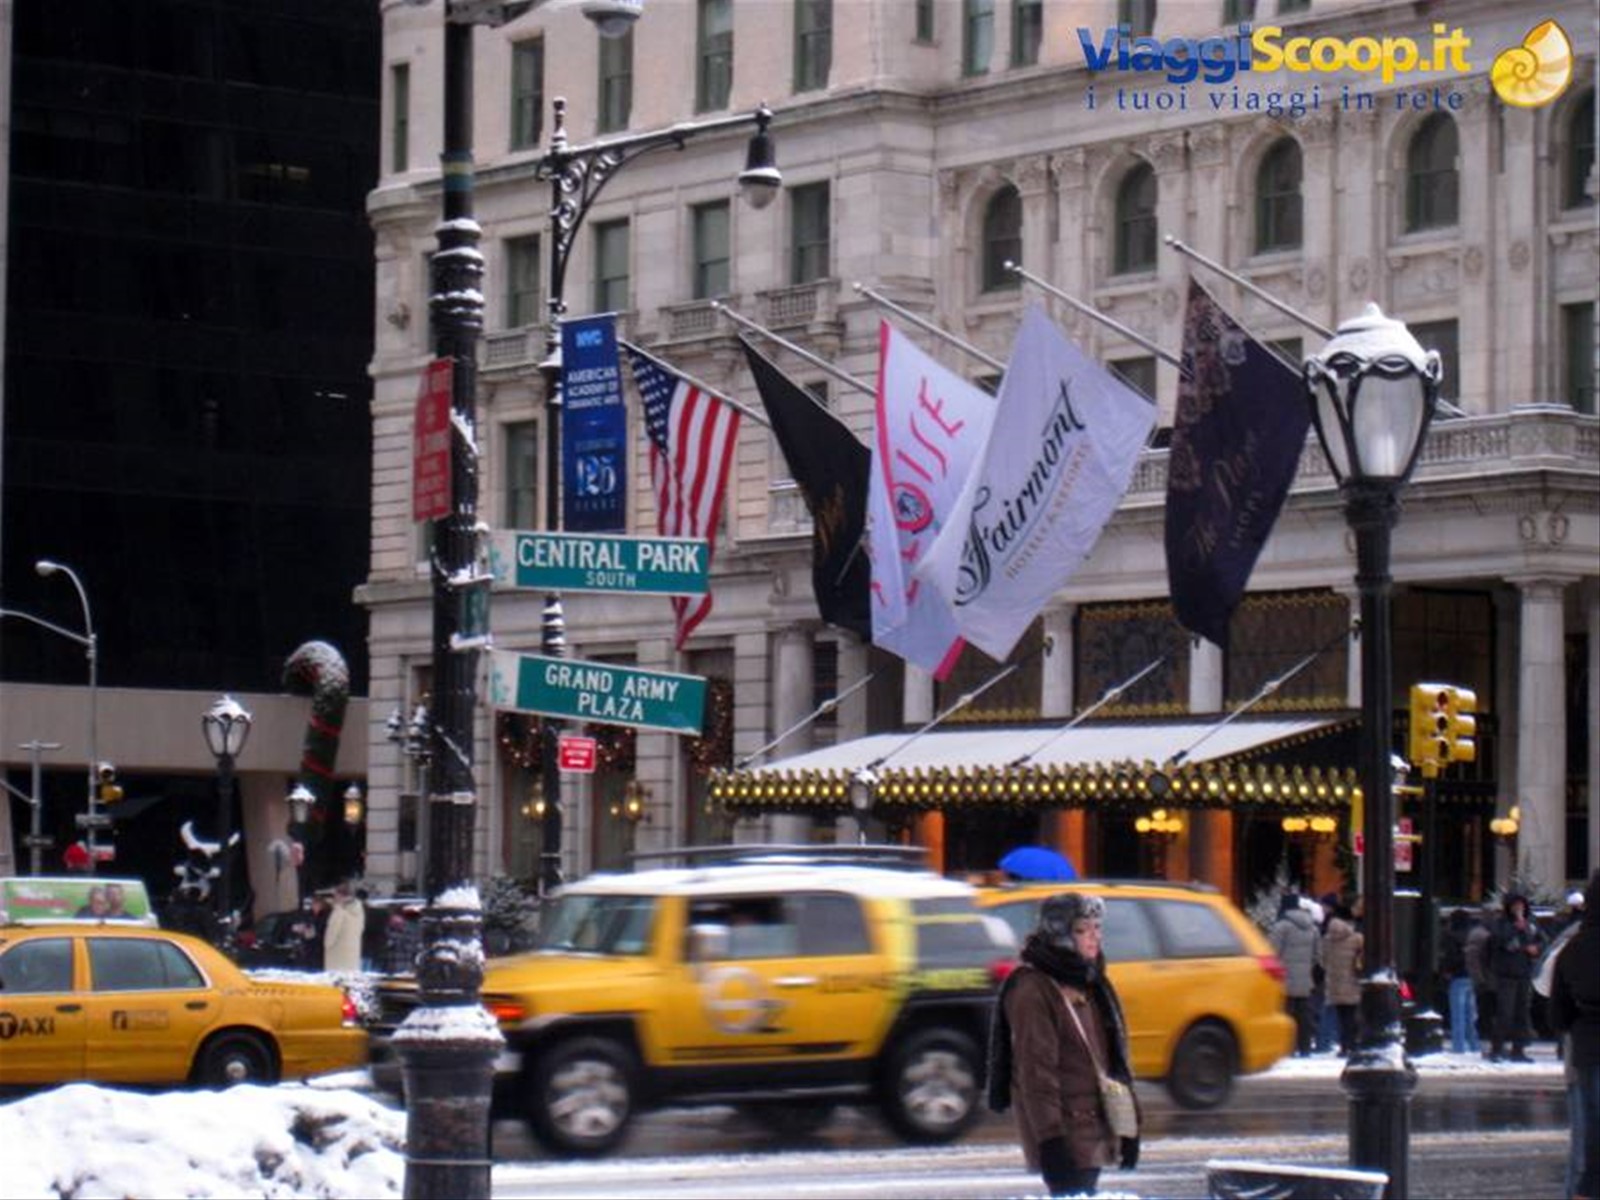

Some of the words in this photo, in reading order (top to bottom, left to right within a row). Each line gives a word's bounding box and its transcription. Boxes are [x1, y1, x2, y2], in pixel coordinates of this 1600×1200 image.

[567, 366, 618, 383] AMERICAN
[576, 455, 617, 496] 125
[954, 378, 1086, 606] Fairmont
[518, 538, 627, 570] CENTRAL
[637, 543, 700, 573] PARK
[586, 571, 637, 587] SOUTH
[545, 664, 613, 693] GRAND
[623, 676, 680, 701] ARMY
[578, 692, 645, 721] PLAZA
[0, 1010, 55, 1038] TAXI
